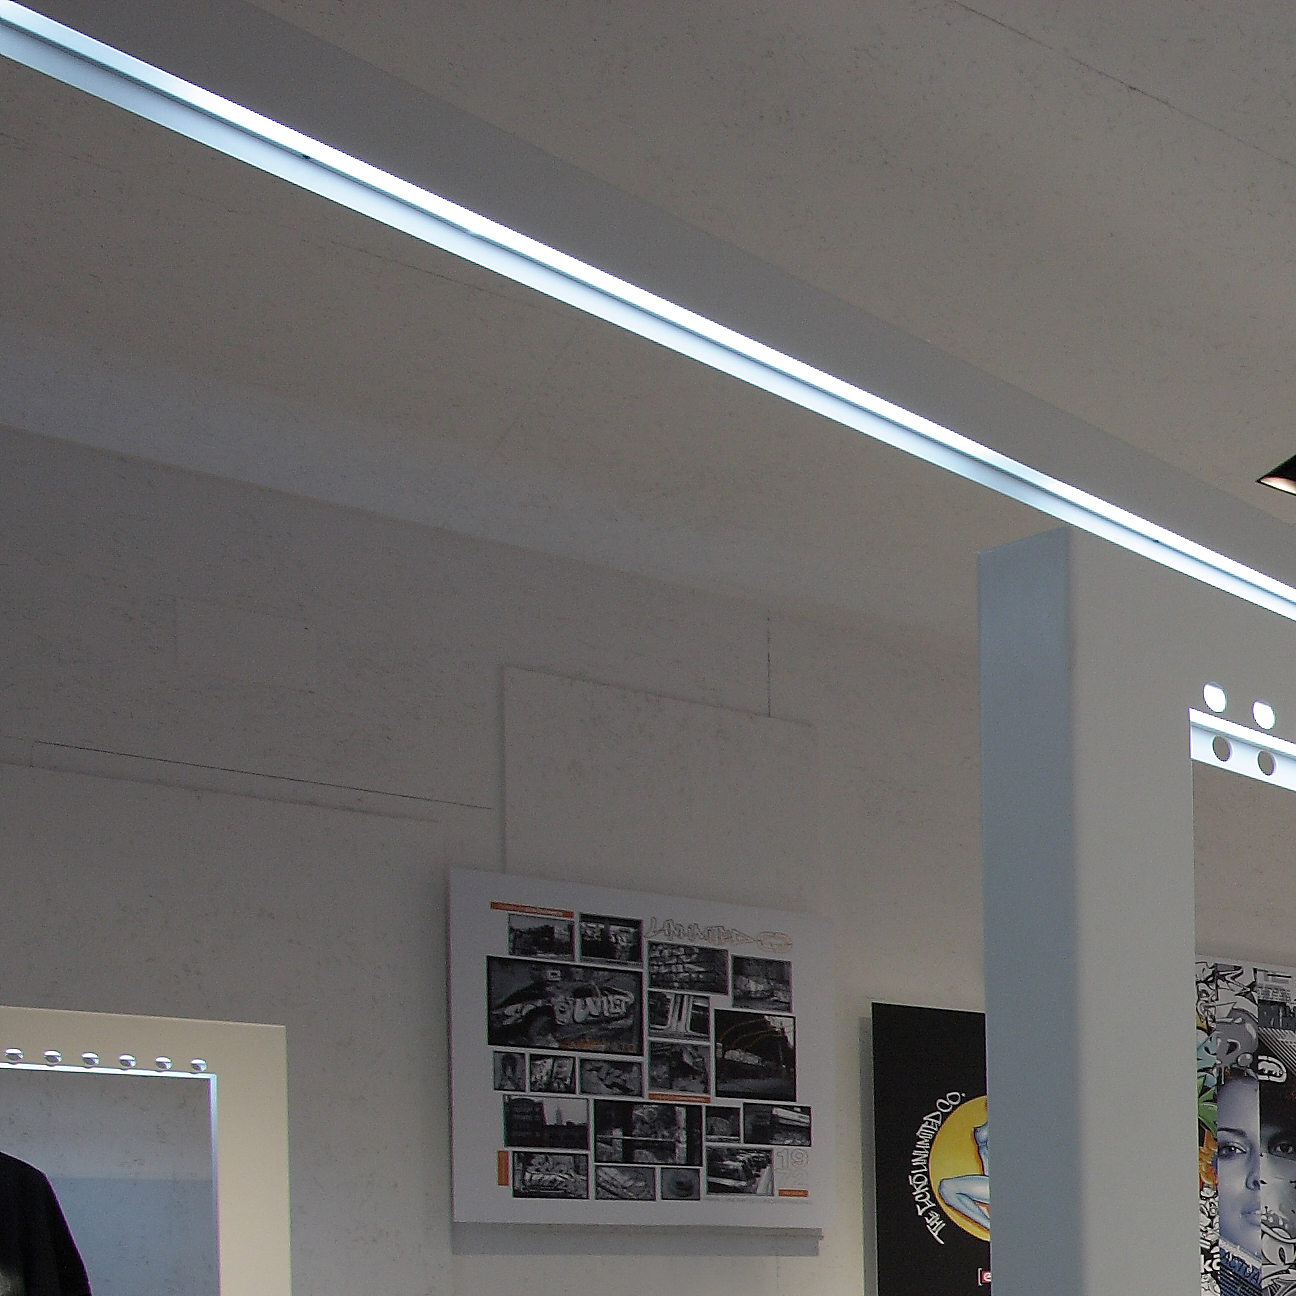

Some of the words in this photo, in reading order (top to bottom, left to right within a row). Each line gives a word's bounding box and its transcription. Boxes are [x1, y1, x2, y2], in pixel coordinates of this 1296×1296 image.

[936, 1091, 966, 1113] CO.
[911, 1111, 943, 1176] UNLIMITED
[925, 1210, 947, 1245] THE
